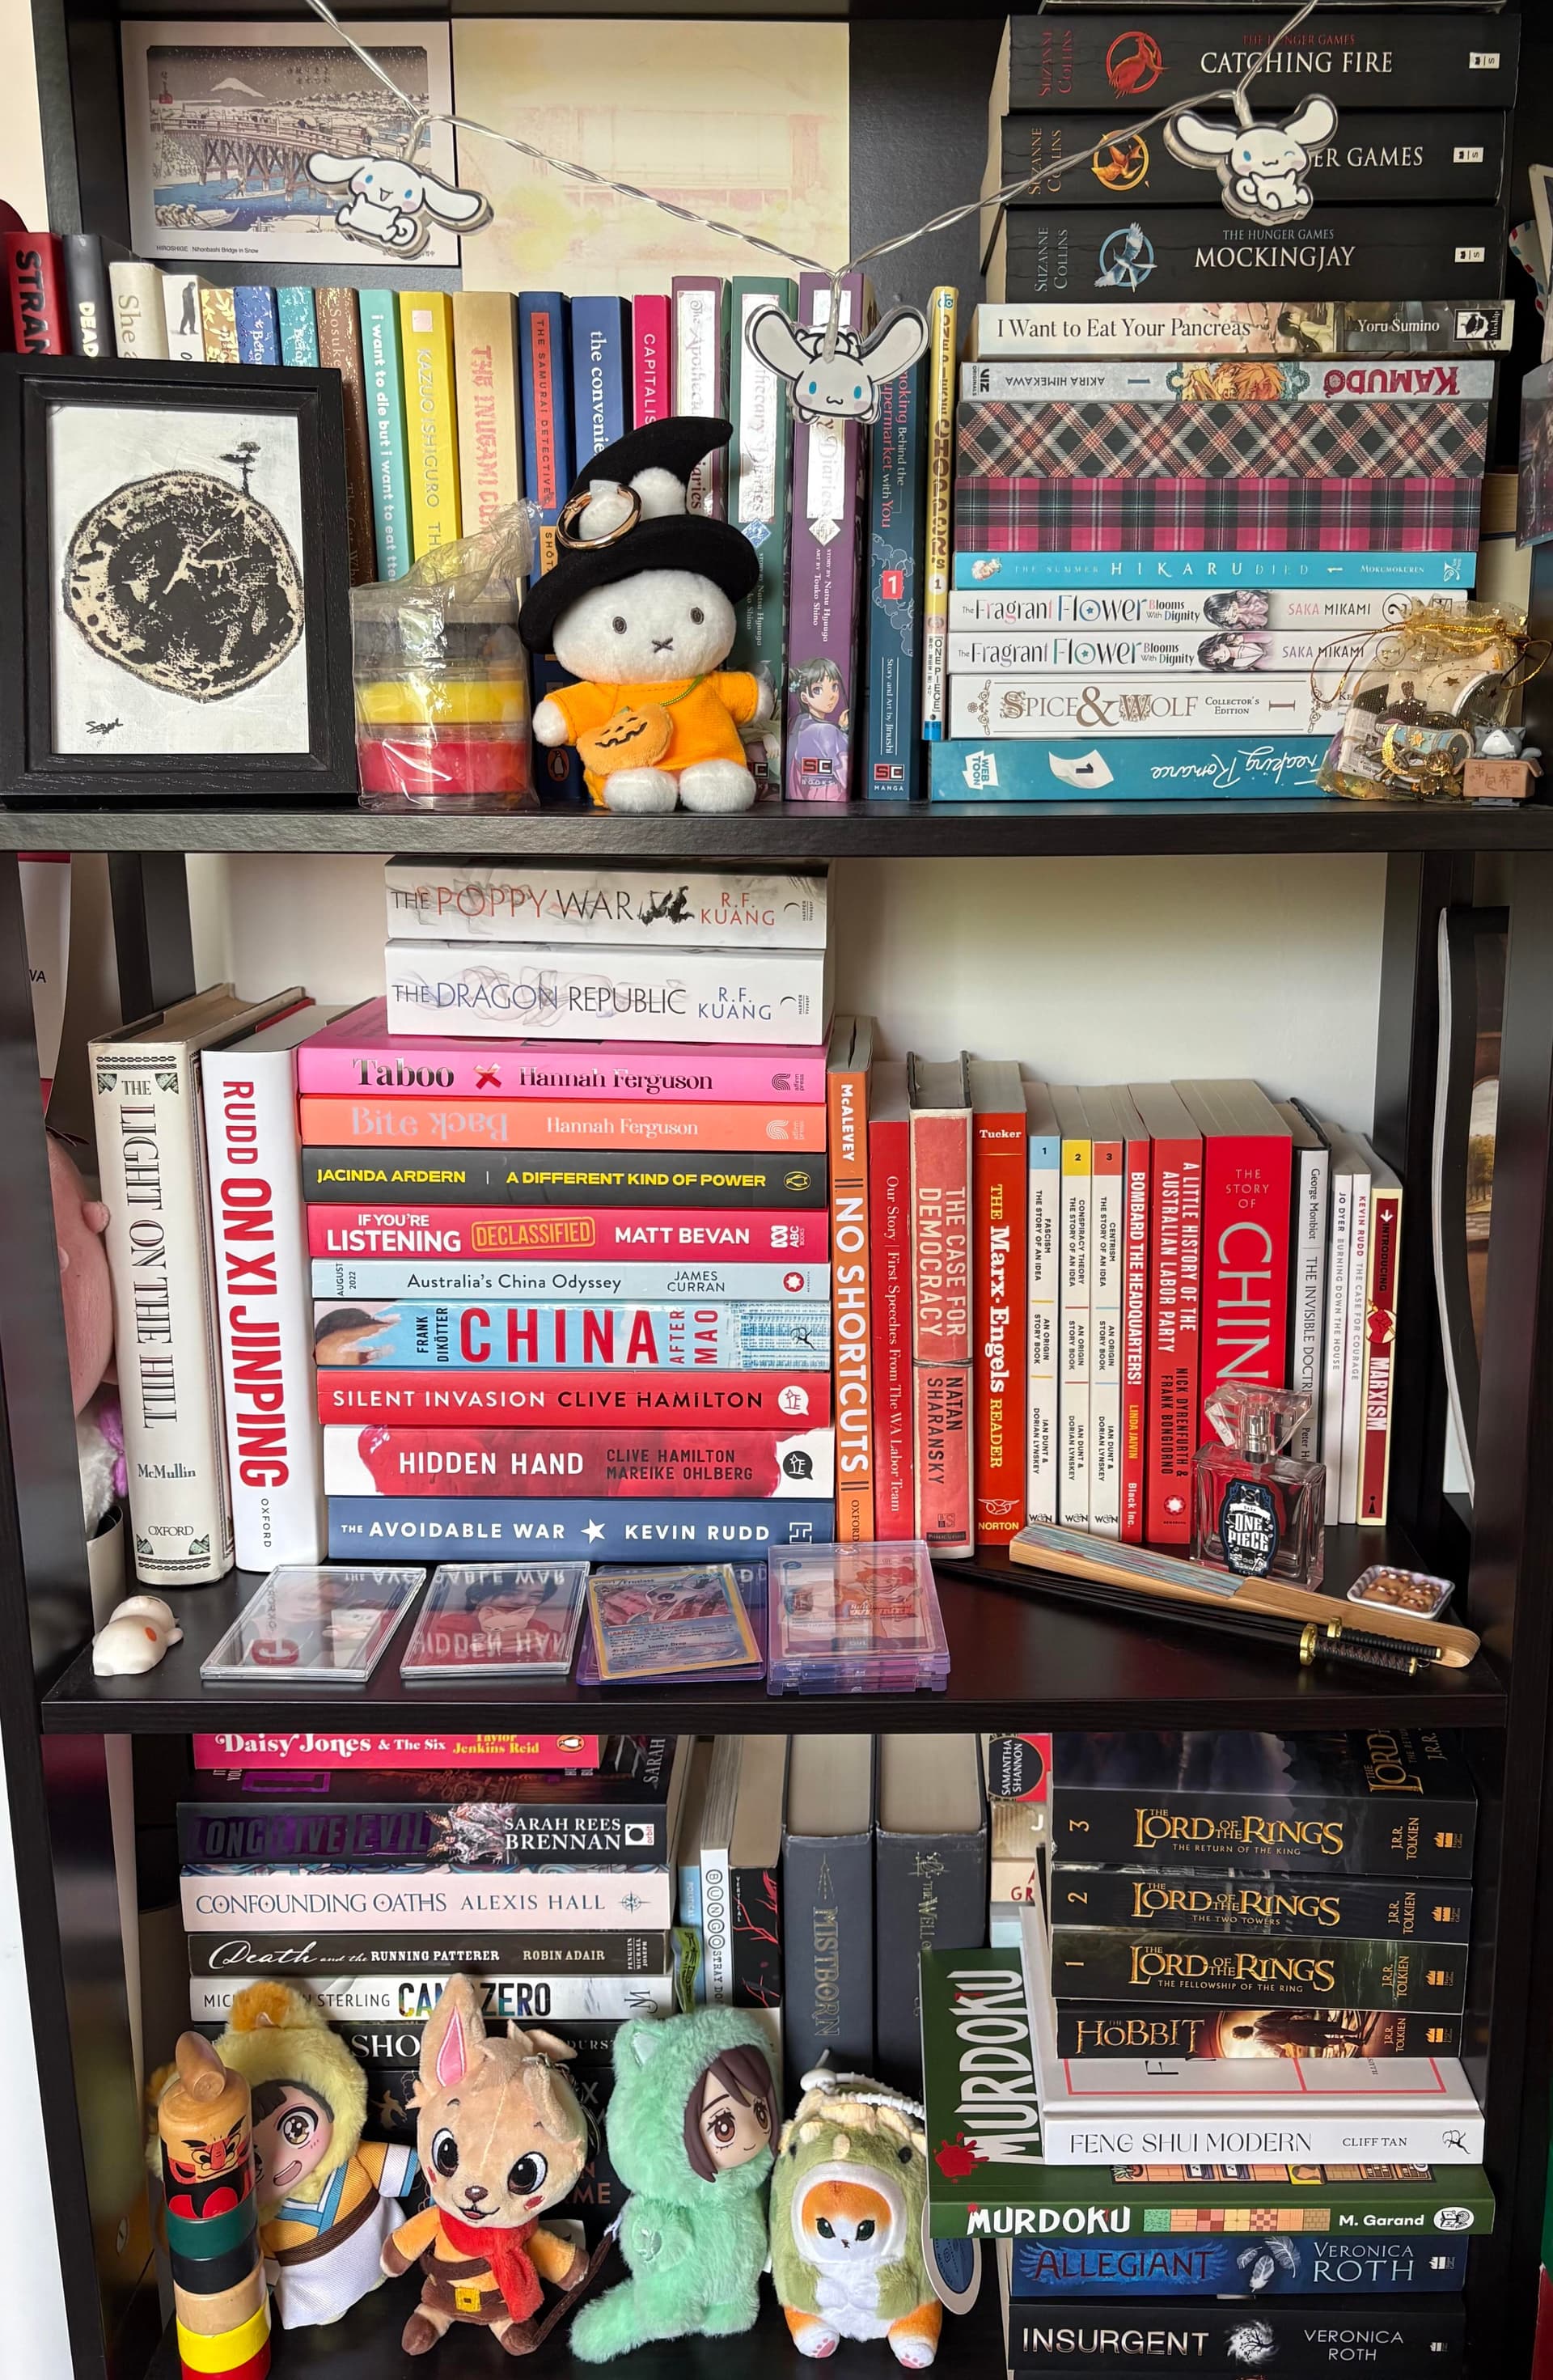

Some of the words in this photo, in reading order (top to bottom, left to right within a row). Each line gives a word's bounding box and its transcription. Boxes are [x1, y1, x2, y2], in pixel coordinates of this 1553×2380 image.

[1200, 52, 1335, 74] CATCHING
[1343, 52, 1393, 73] FIRE
[1344, 146, 1423, 167] GAMES
[1223, 228, 1243, 240] THE
[1247, 228, 1294, 240] HUNGER
[1298, 228, 1334, 240] GAMES
[192, 246, 222, 254] Nihonbashi
[1035, 227, 1049, 292] SUZANNE
[1053, 229, 1068, 290] COLLINS
[1194, 247, 1356, 272] MOCKINGJAY
[78, 303, 99, 357] DEAD
[119, 294, 141, 344] She
[997, 320, 1004, 337] I
[1009, 319, 1058, 337] Want
[1062, 320, 1081, 337] to
[1086, 319, 1117, 337] Eat
[1121, 319, 1166, 337] Your
[1170, 319, 1250, 337] Pancreas
[1357, 318, 1390, 333] Yoru
[1393, 318, 1440, 332] Sumino
[371, 325, 384, 366] want
[535, 321, 544, 348] THE
[590, 332, 607, 361] the
[373, 371, 384, 392] to
[417, 349, 435, 413] KAZUO
[537, 354, 546, 411] SAMURAI
[1005, 375, 1067, 387] HIMEKAWA
[1068, 375, 1106, 387] AKIRA
[1322, 366, 1460, 397] KAMUDO
[375, 395, 386, 417] die
[377, 421, 388, 449] but
[421, 417, 439, 509] ISHIGURO
[812, 576, 820, 603] Touko
[1288, 604, 1319, 616] SAKA
[1324, 604, 1371, 616] MIKAMI
[971, 641, 1047, 667] Fragrant
[1053, 637, 1142, 665] Flower
[1143, 642, 1179, 653] Blooms
[1159, 652, 1195, 667] Dignity
[700, 908, 775, 925] KUANG
[698, 1002, 772, 1020] KUANG
[121, 1079, 151, 1095] THE
[223, 1081, 258, 1166] RUDD
[547, 1116, 615, 1135] Hannah
[620, 1119, 698, 1141] Ferguson
[840, 1084, 855, 1162] McALEVEY
[980, 1128, 1021, 1138] Tucker
[120, 1104, 162, 1211] LIGHT
[316, 1168, 388, 1184] JACINDA
[391, 1169, 466, 1184] ARDERN
[506, 1171, 518, 1185] A
[525, 1171, 622, 1186] DIFFERENT
[627, 1172, 671, 1186] KIND
[675, 1173, 698, 1186] OF
[701, 1173, 766, 1187] POWER
[1236, 1170, 1261, 1179] THE
[991, 1184, 1003, 1220] THE
[1131, 1171, 1146, 1235] BOMBARD
[1226, 1184, 1268, 1195] STORY
[220, 1178, 274, 1241] ON
[946, 1188, 964, 1229] THE
[1160, 1171, 1179, 1254] AUSTRALIAN
[1238, 1198, 1256, 1209] OF
[476, 1220, 590, 1247] DECLASSIFIED
[615, 1228, 675, 1243] MATT
[680, 1228, 750, 1244] BEVAN
[836, 1197, 864, 1254] NO
[129, 1220, 166, 1268] ON
[327, 1228, 461, 1252] LISTENING
[1131, 1238, 1145, 1264] THE
[225, 1251, 277, 1296] XI
[917, 1188, 942, 1336] DEMOCRACY
[946, 1233, 964, 1289] CASE
[407, 1273, 493, 1289] Australia's
[497, 1273, 546, 1289] China
[552, 1273, 622, 1293] Odyssey
[1158, 1260, 1173, 1300] LABOR
[133, 1277, 171, 1345] THE
[946, 1294, 965, 1336] FOR
[987, 1225, 1009, 1393] Marx-Engels
[1304, 1284, 1317, 1343] INVISIBLE
[460, 1308, 658, 1363] CHINA
[1128, 1267, 1144, 1384] HEADQUARTERS!
[1158, 1309, 1174, 1353] PARTY
[837, 1264, 868, 1474] SHORTCUTS
[138, 1353, 176, 1429] HILL
[229, 1305, 289, 1489] JINPING
[333, 1391, 414, 1407] SILENT
[425, 1391, 544, 1407] INVASION
[557, 1391, 626, 1408] CLIVE
[637, 1392, 763, 1408] HAMILTON
[946, 1377, 963, 1431] NATAN
[1161, 1375, 1173, 1411] FRANK
[1367, 1357, 1388, 1432] MARXISM
[927, 1378, 945, 1485] SHARANSKY
[991, 1399, 1003, 1469] READER
[1162, 1416, 1171, 1476] BONGIORNO
[138, 1465, 196, 1480] McMullin
[400, 1452, 496, 1474] HIDDEN
[511, 1453, 583, 1475] HAND
[606, 1467, 675, 1480] MAREIKE
[683, 1467, 752, 1480] OHLBERG
[148, 1526, 193, 1536] OXFORD
[260, 1498, 271, 1548] OXFORD
[341, 1525, 363, 1534] THE
[369, 1522, 505, 1538] AVOIDABLE
[514, 1522, 565, 1538] WAR
[625, 1524, 700, 1540] KEVIN
[707, 1524, 769, 1540] RUDD
[978, 1522, 1019, 1531] NORTON
[1234, 1517, 1263, 1535] ONE
[1227, 1529, 1269, 1553] PIECE
[453, 1743, 506, 1754] Jenkins
[510, 1742, 539, 1754] Reid
[1002, 1739, 1012, 1795] SAMANTHA
[1013, 1743, 1022, 1792] SHANNON
[505, 1819, 569, 1831] SARAH
[575, 1818, 620, 1831] REES
[505, 1834, 621, 1850] BRENNAN
[1407, 1817, 1418, 1860] TOLKIEN
[196, 1893, 366, 1913] CONFOUNDING
[373, 1892, 446, 1912] OATHS
[460, 1895, 538, 1910] ALEXIS
[548, 1895, 605, 1910] HALL
[1403, 1891, 1415, 1933] TOLKIEN
[523, 1950, 560, 1961] ROBIN
[561, 1950, 605, 1961] ADAIR
[813, 1907, 840, 2036] MISTBORN
[1397, 1955, 1408, 1999] TOLKIEN
[317, 1993, 390, 2008] STERLING
[946, 1969, 1039, 2164] MURDOKU
[1070, 2133, 1133, 2153] FENG
[1142, 2133, 1199, 2153] SHUI
[1206, 2133, 1310, 2152] MODERN
[1343, 2136, 1377, 2146] CLIFF
[1382, 2136, 1407, 2146] TAN
[967, 2206, 1130, 2235] MURDOKU
[1339, 2215, 1358, 2226] M.
[1363, 2214, 1424, 2227] Garand
[1314, 2243, 1412, 2258] VERONICA
[1034, 2251, 1214, 2280] ALLEGIANT
[1313, 2260, 1413, 2281] ROTH
[1022, 2329, 1208, 2356] INSURGENT
[1304, 2330, 1403, 2344] VERONICA
[1328, 2348, 1376, 2361] ROTH
